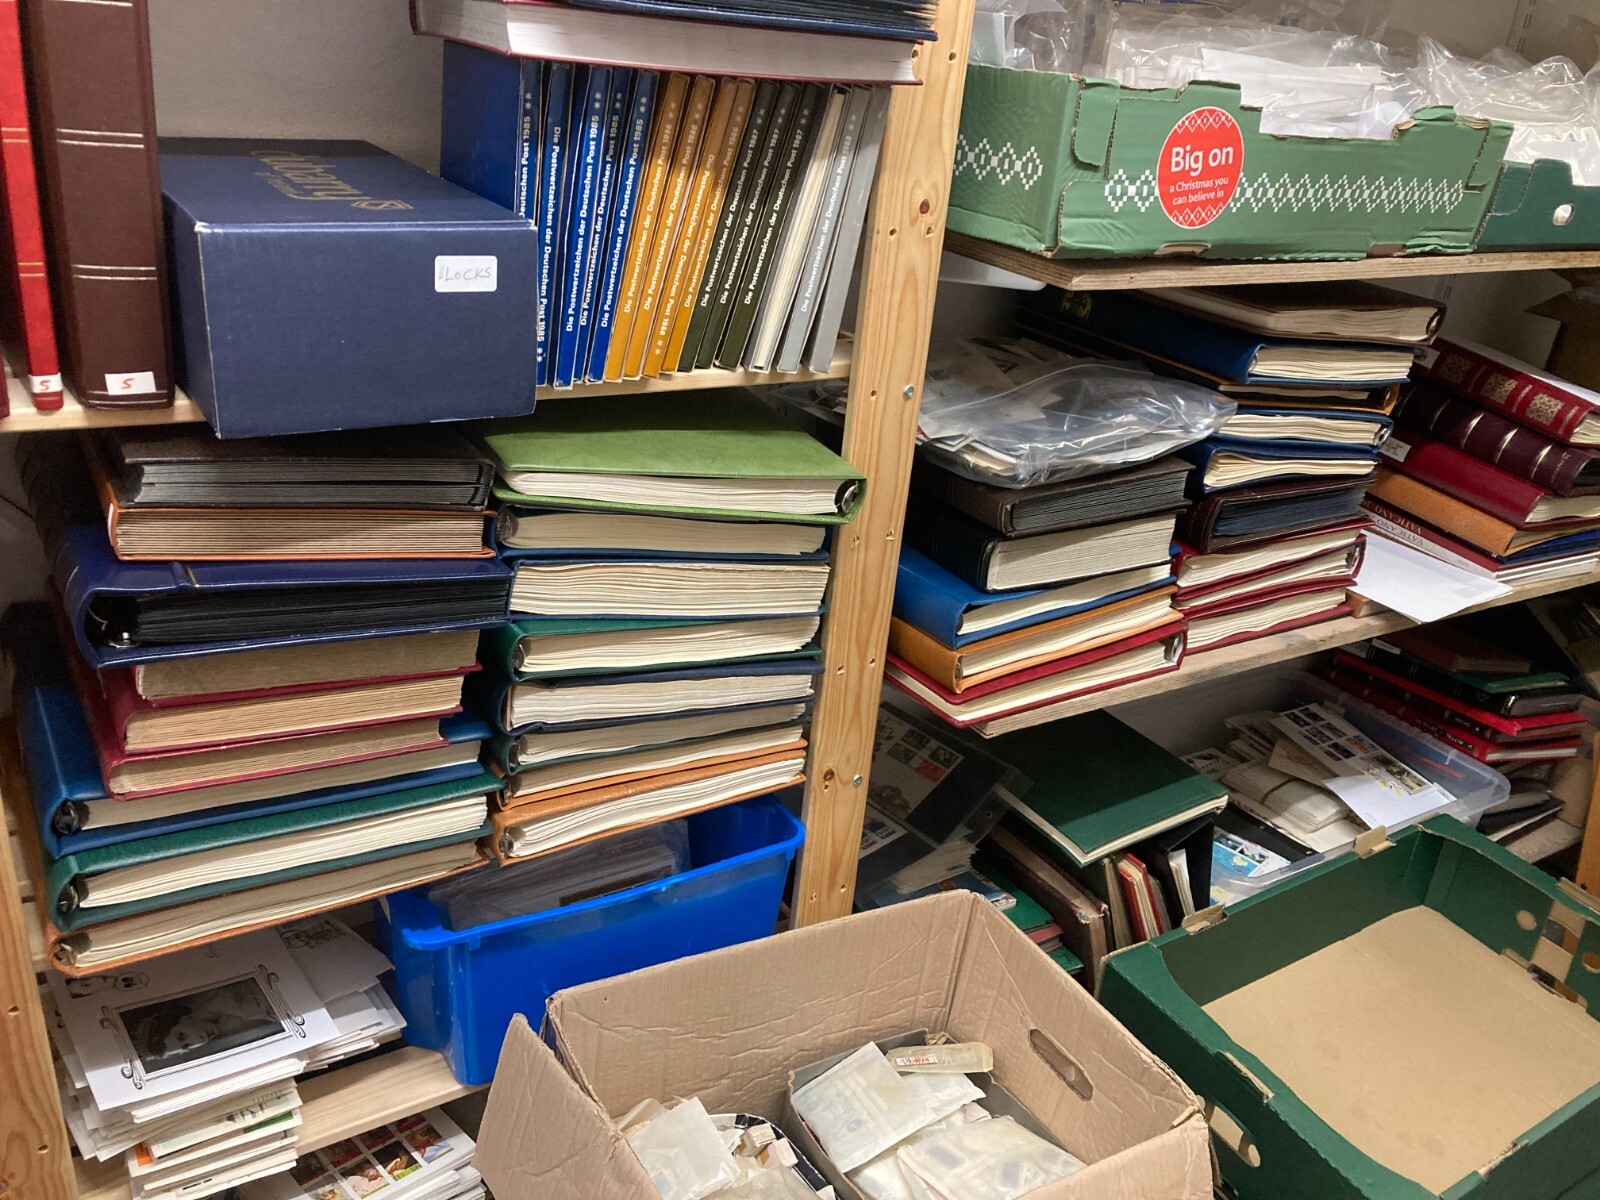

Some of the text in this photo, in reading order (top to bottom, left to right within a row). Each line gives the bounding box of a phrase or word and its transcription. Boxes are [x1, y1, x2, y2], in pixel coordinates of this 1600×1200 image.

[553, 126, 561, 143] Die
[589, 115, 598, 138] 1985
[609, 115, 618, 137] 1985
[521, 142, 529, 164] Post
[586, 140, 595, 163] Post
[605, 140, 615, 161] Post
[836, 156, 846, 174] Post
[1171, 145, 1234, 176] Big on
[546, 145, 559, 226] Postwertzeichen
[579, 165, 592, 217] Deutschen
[597, 163, 611, 214] Deutschen
[825, 175, 841, 217] Deutschen
[1172, 189, 1224, 205] can believe in
[1176, 178, 1214, 192] Christmas
[1214, 176, 1229, 188] you
[600, 118, 643, 327] Die Postwertzeichen der Deutschen Post 1985
[624, 123, 672, 312] Die Postwertzeichen der Deutschen Post 1986
[643, 123, 697, 310] Die Postwertzeichen der Deutschen Post 1986
[684, 294, 692, 307] Die
[688, 228, 710, 292] Postwertzeichen
[710, 168, 726, 210] Deutschen
[722, 147, 733, 166] Post
[728, 126, 738, 145] 1986
[700, 128, 758, 306] Die Postwertzeichen der Deutschen Post 1987
[719, 128, 779, 303] Die Postwertzeichen der Deutschen Post 1987
[744, 129, 802, 304] Die Postwertzeichen der Deutschen Post 1987
[821, 218, 830, 233] der
[659, 153, 714, 335] Die Postwertzeichen der Deutschen Post 1986
[438, 265, 492, 282] BLOCKS
[540, 246, 551, 296] Deutschen
[567, 237, 583, 314] Postwertzeichen
[582, 233, 599, 308] Postwertzeichen
[804, 234, 826, 297] Postwertzeichen
[538, 298, 547, 318] Post
[579, 310, 588, 325] Die
[800, 298, 809, 312] Die
[536, 320, 545, 341] 1985
[1376, 506, 1421, 534] VATICANO
[1377, 520, 1423, 546] VATICANO
